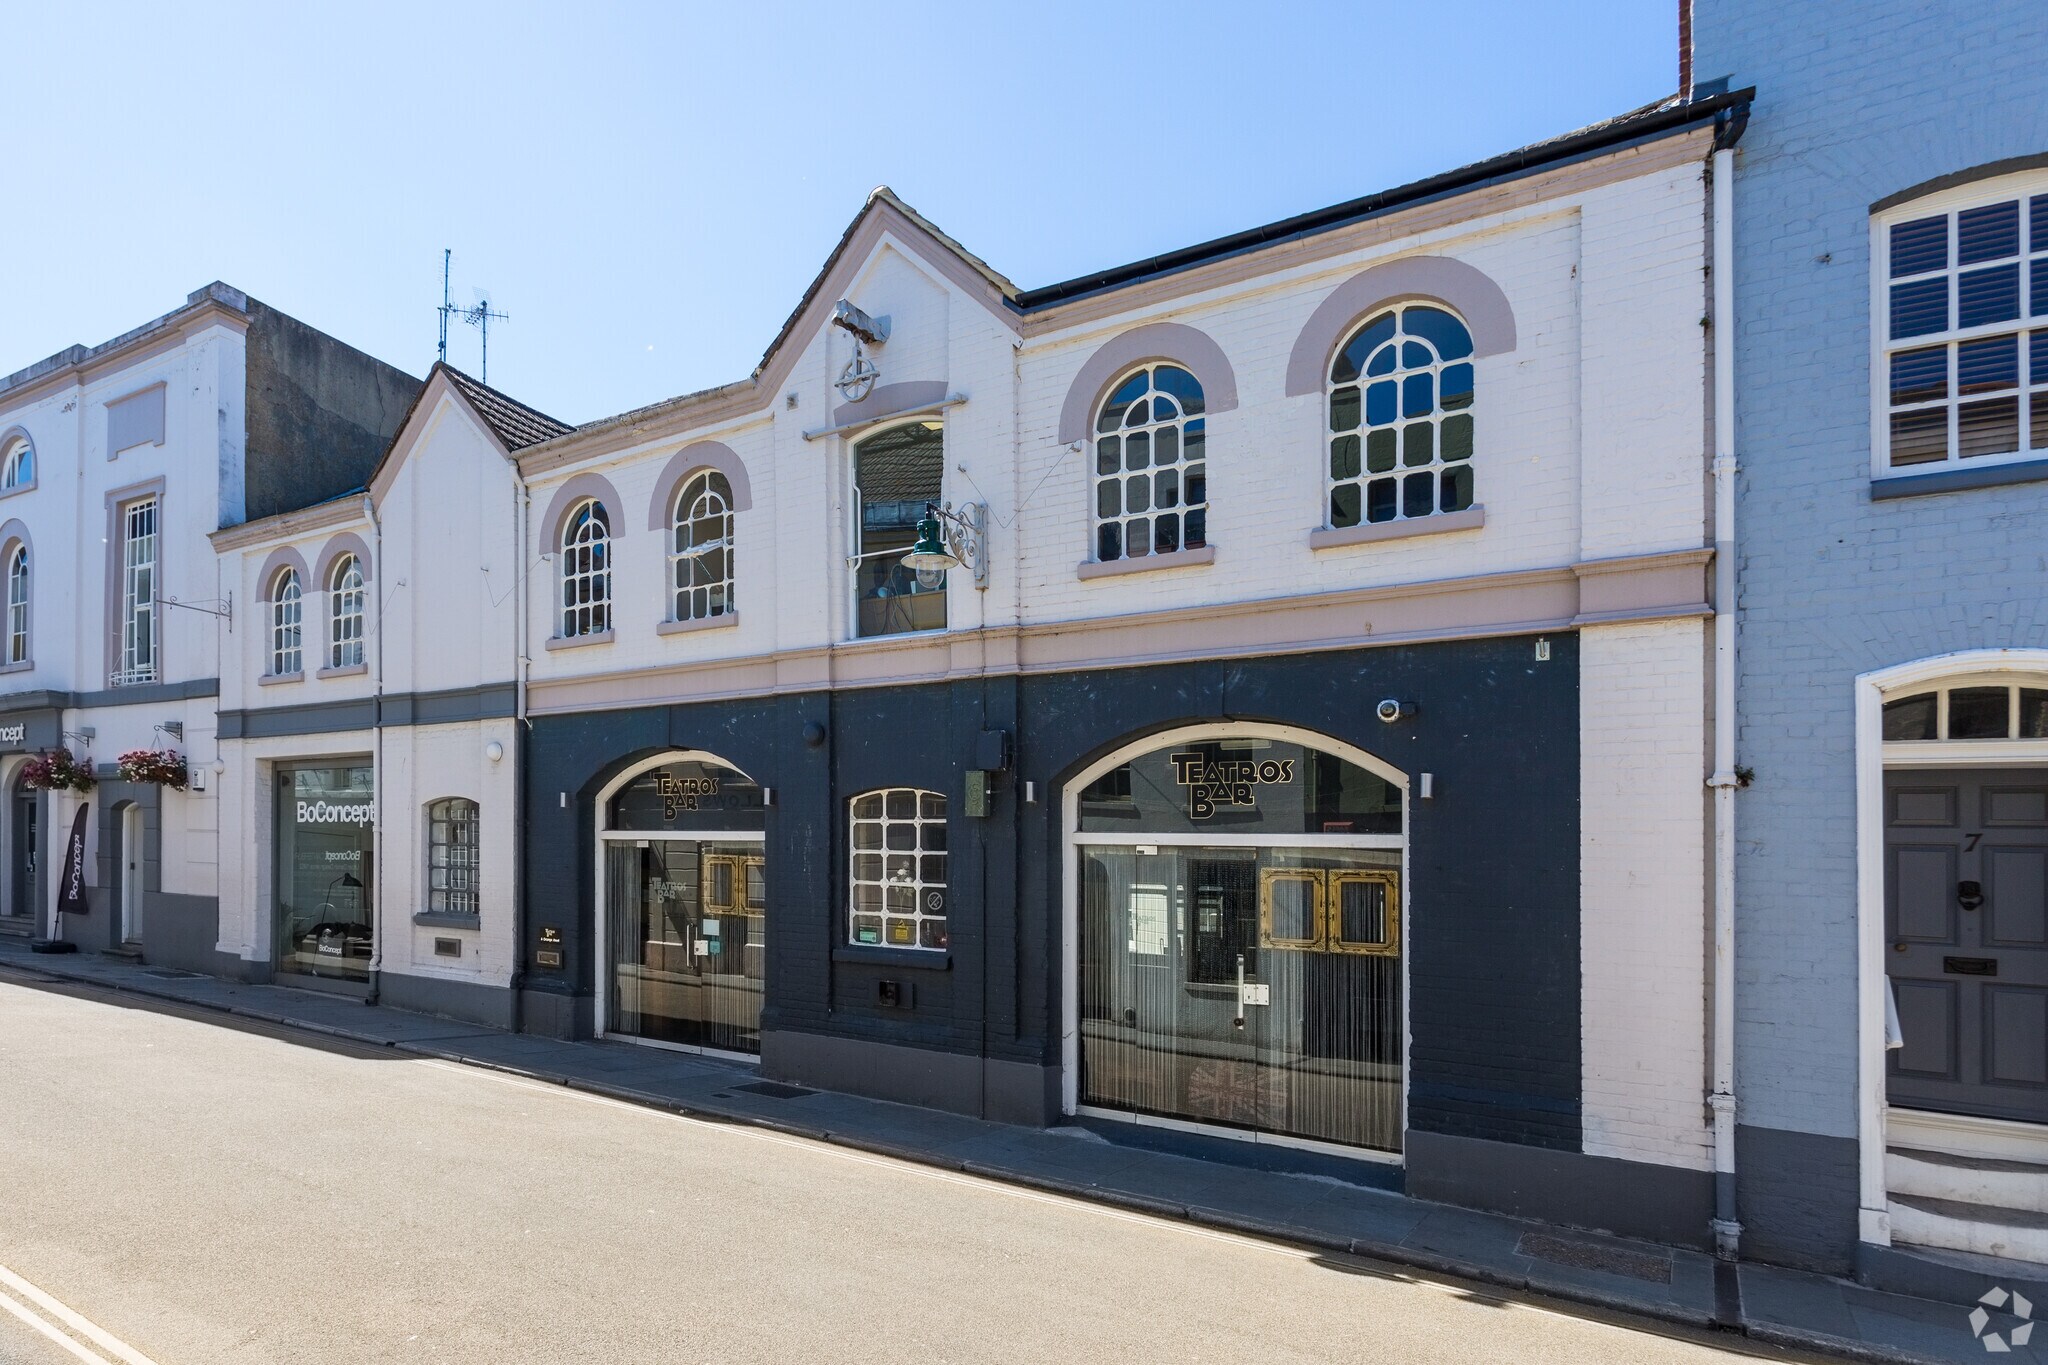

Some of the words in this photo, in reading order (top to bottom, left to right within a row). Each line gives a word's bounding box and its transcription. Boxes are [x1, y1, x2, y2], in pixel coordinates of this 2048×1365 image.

[1171, 752, 1295, 785] TEATROS
[653, 772, 719, 796] TEATROS
[297, 800, 375, 828] BoConcept
[664, 792, 698, 820] BAR
[1190, 780, 1255, 820] BAR
[1963, 833, 1983, 853] 7
[68, 834, 83, 900] BoConcept
[652, 877, 687, 892] TEATROS
[658, 889, 676, 904] BAR
